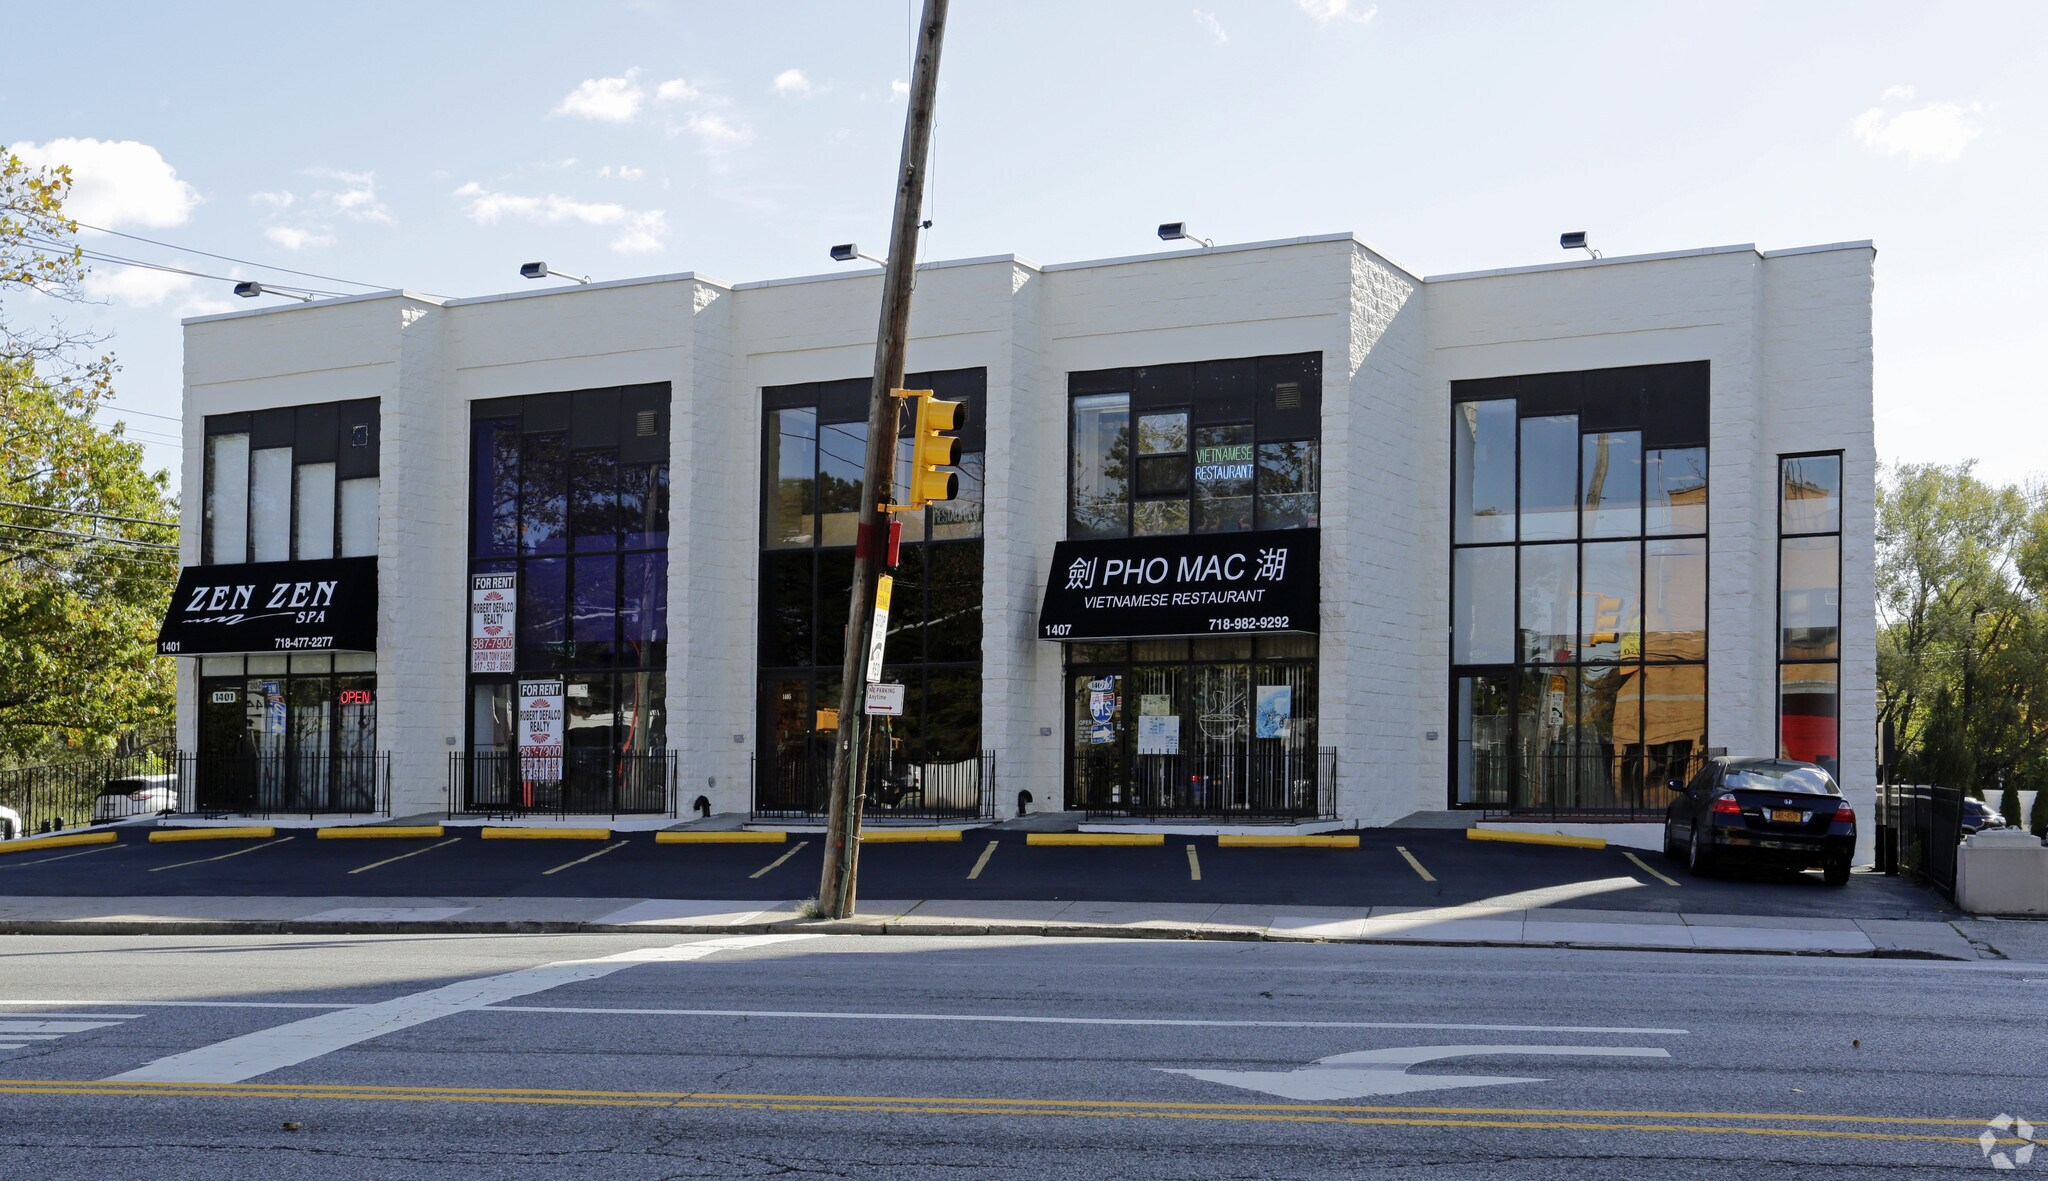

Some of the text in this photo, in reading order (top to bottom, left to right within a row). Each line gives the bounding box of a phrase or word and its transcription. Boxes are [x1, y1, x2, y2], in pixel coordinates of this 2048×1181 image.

[1195, 446, 1253, 464] VIETNAMESE
[1194, 464, 1254, 480] RESTAURANT
[1102, 557, 1168, 586] PHO
[1176, 553, 1246, 582] MAC
[1254, 548, 1287, 582] 湖
[476, 577, 513, 589] FOR RENT
[185, 580, 338, 612] ZEN ZEN
[1084, 589, 1265, 609] VIETNAMESE RESTAURANT
[474, 602, 513, 613] ROBERT DEFALCO
[296, 611, 326, 624] SPA
[483, 614, 503, 624] REALTY
[1208, 616, 1289, 630] 718-982-9292
[1045, 624, 1072, 636] 1407
[161, 642, 180, 652] 1401
[274, 636, 333, 649] 718-477-2277
[473, 638, 513, 649] 987-7900
[522, 685, 537, 696] FOR
[539, 684, 560, 695] RENT
[214, 693, 234, 702] 1401
[340, 690, 370, 704] OPEN
[520, 710, 538, 720] ROBERT
[530, 721, 550, 732] REALTY
